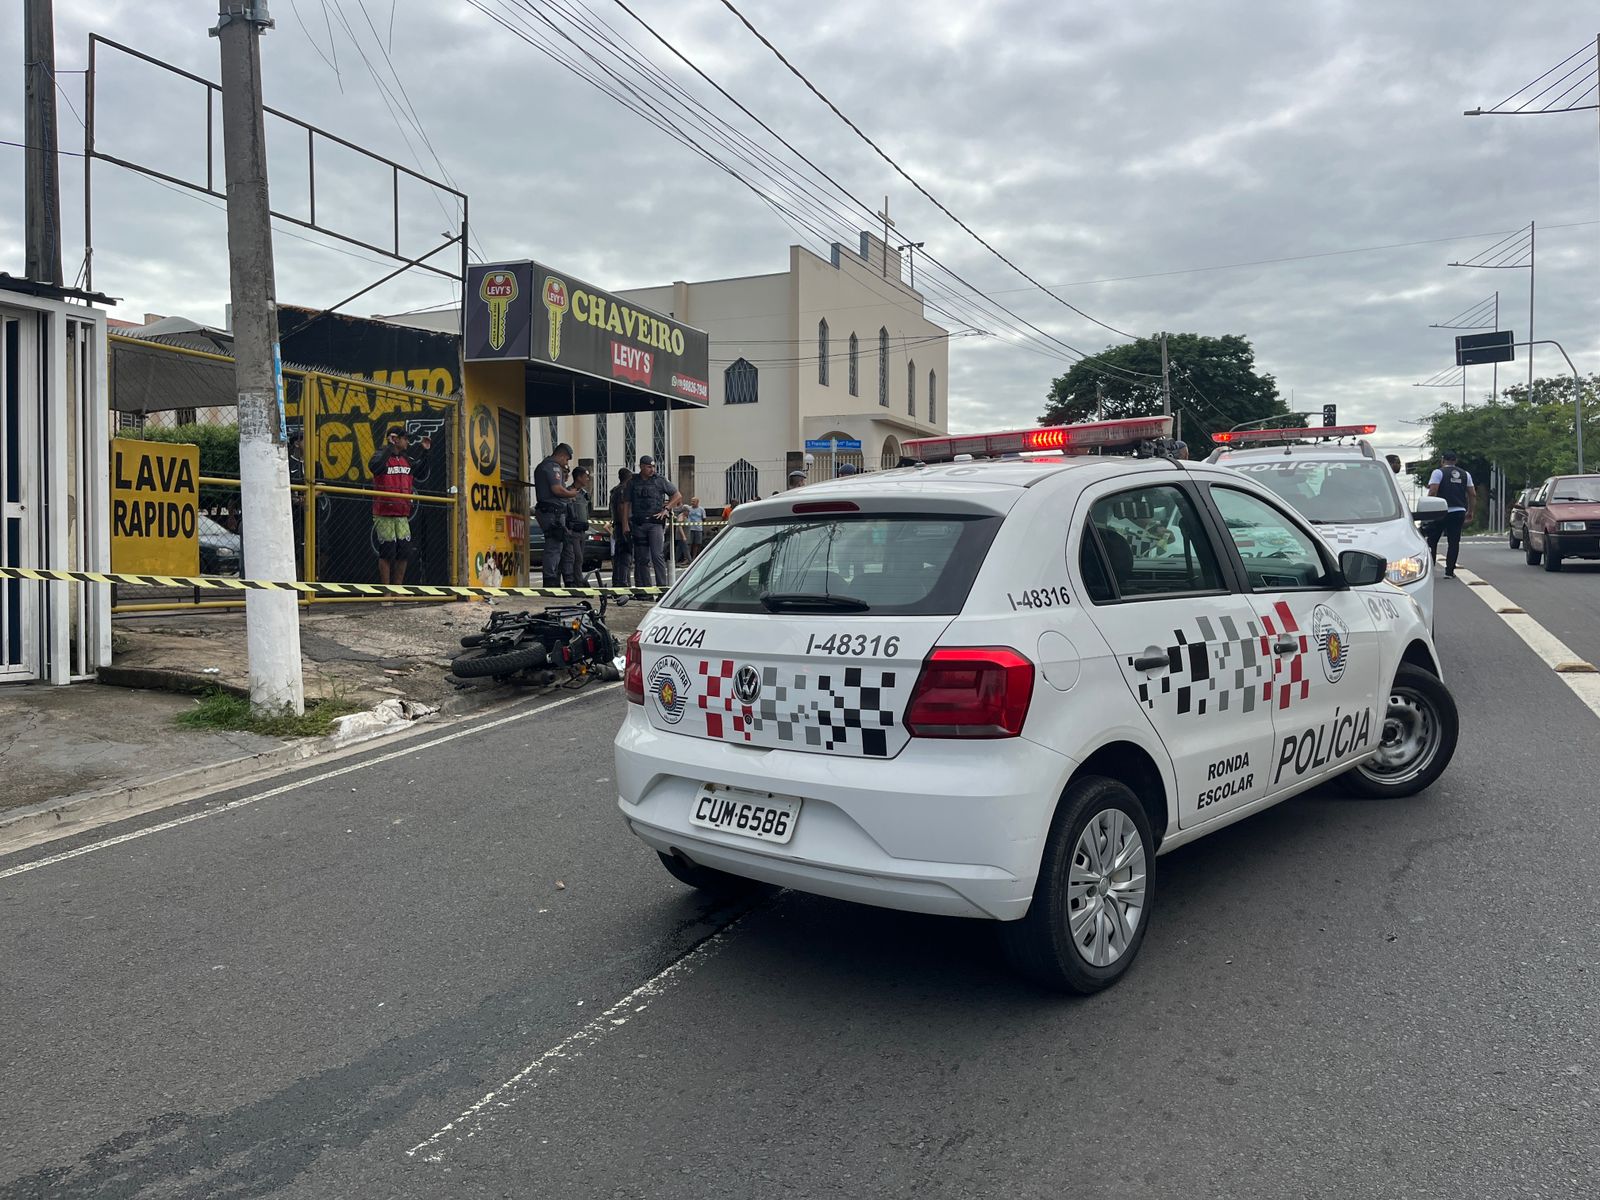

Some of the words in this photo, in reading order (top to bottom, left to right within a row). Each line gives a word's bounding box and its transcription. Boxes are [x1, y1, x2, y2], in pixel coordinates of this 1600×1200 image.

[571, 289, 685, 357] CHAVEIRO
[613, 343, 650, 374] LEVY'S
[115, 451, 195, 493] LAVA
[113, 499, 195, 540] RAPIDO
[1007, 586, 1071, 611] I-48316
[1378, 598, 1399, 619] 190
[644, 622, 706, 648] POLÍCIA
[805, 633, 900, 658] I-48316
[669, 659, 689, 688] MILITAR
[1274, 705, 1370, 784] POLÍCIA
[1207, 751, 1250, 781] RONDA
[1197, 773, 1254, 810] ESCOLAR
